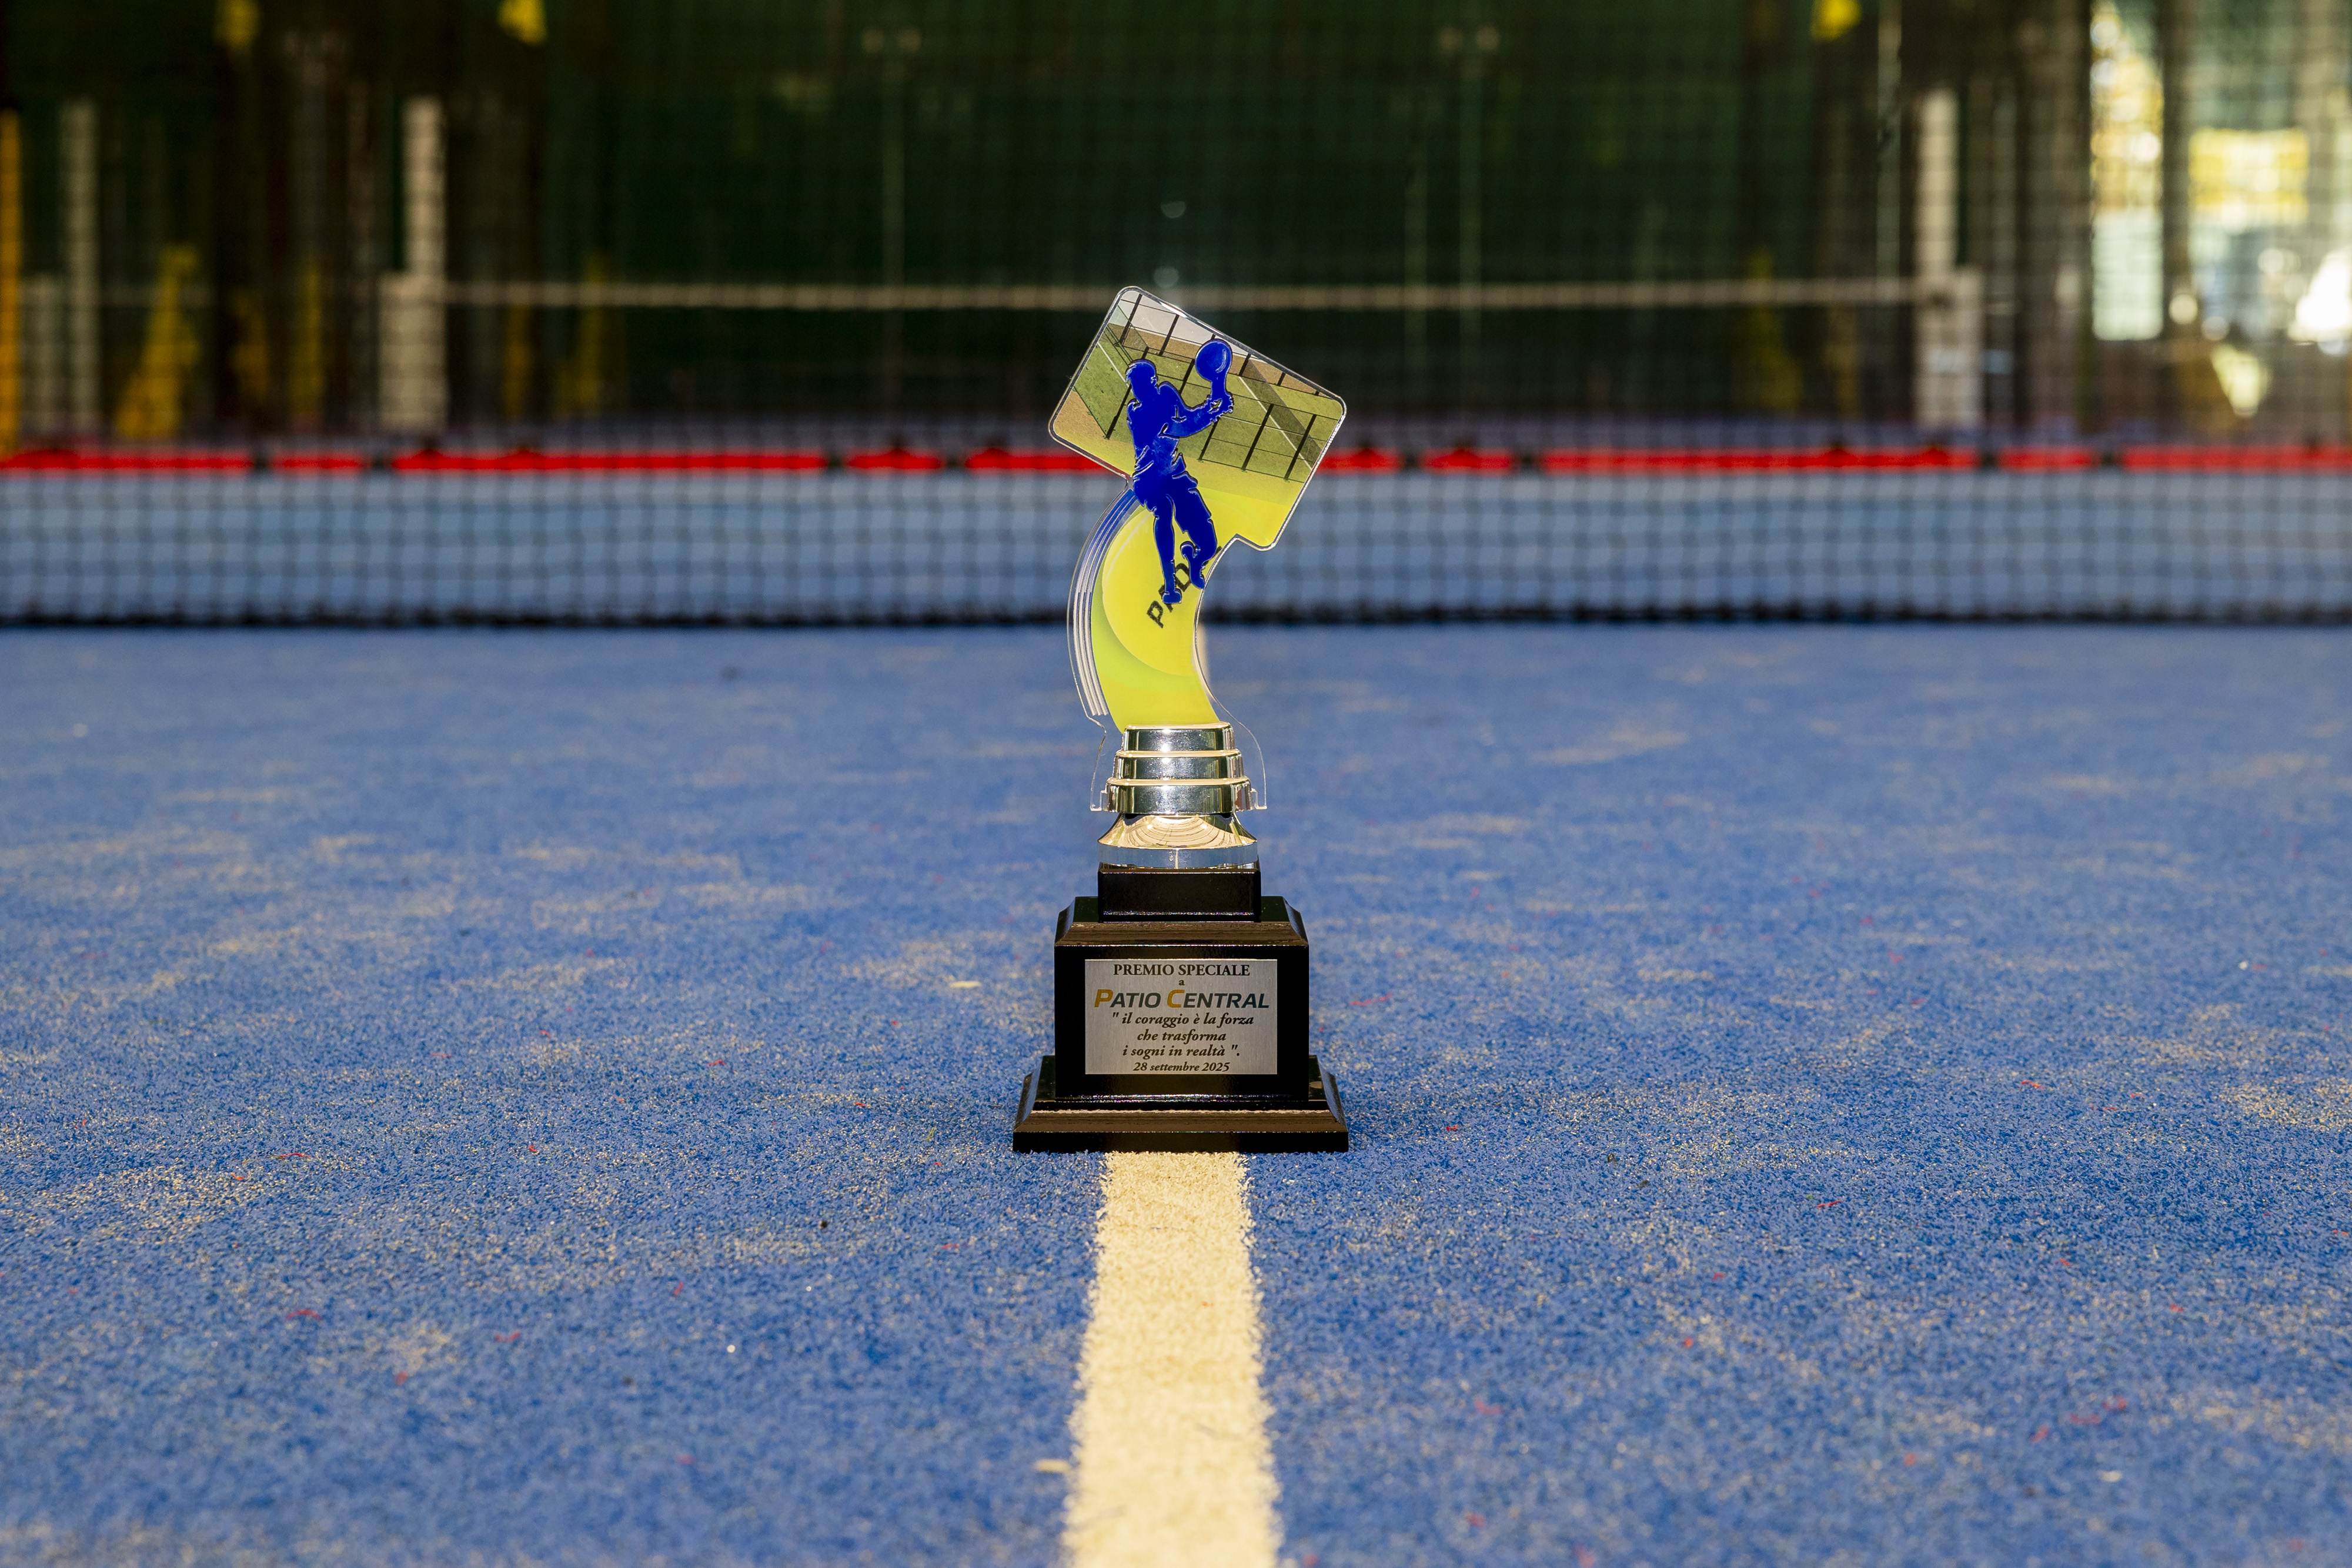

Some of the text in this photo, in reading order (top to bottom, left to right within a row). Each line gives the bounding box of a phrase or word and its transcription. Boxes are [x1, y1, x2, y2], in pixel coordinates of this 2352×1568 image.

[1114, 964, 1250, 976] PREMIO SPECIALE
[1094, 989, 1269, 1008] PATIO CENTRAL
[1122, 1012, 1132, 1024] il
[1135, 1014, 1189, 1028] coraggio
[1193, 1013, 1200, 1024] è
[1204, 1012, 1216, 1024] la
[1218, 1012, 1254, 1028] forza
[1137, 1029, 1226, 1044] che trasforma
[1122, 1045, 1128, 1055] i
[1131, 1045, 1165, 1059] sogni
[1169, 1045, 1182, 1056] in
[1187, 1044, 1225, 1056] realtà
[1133, 1061, 1230, 1072] 28 settembre 2025
